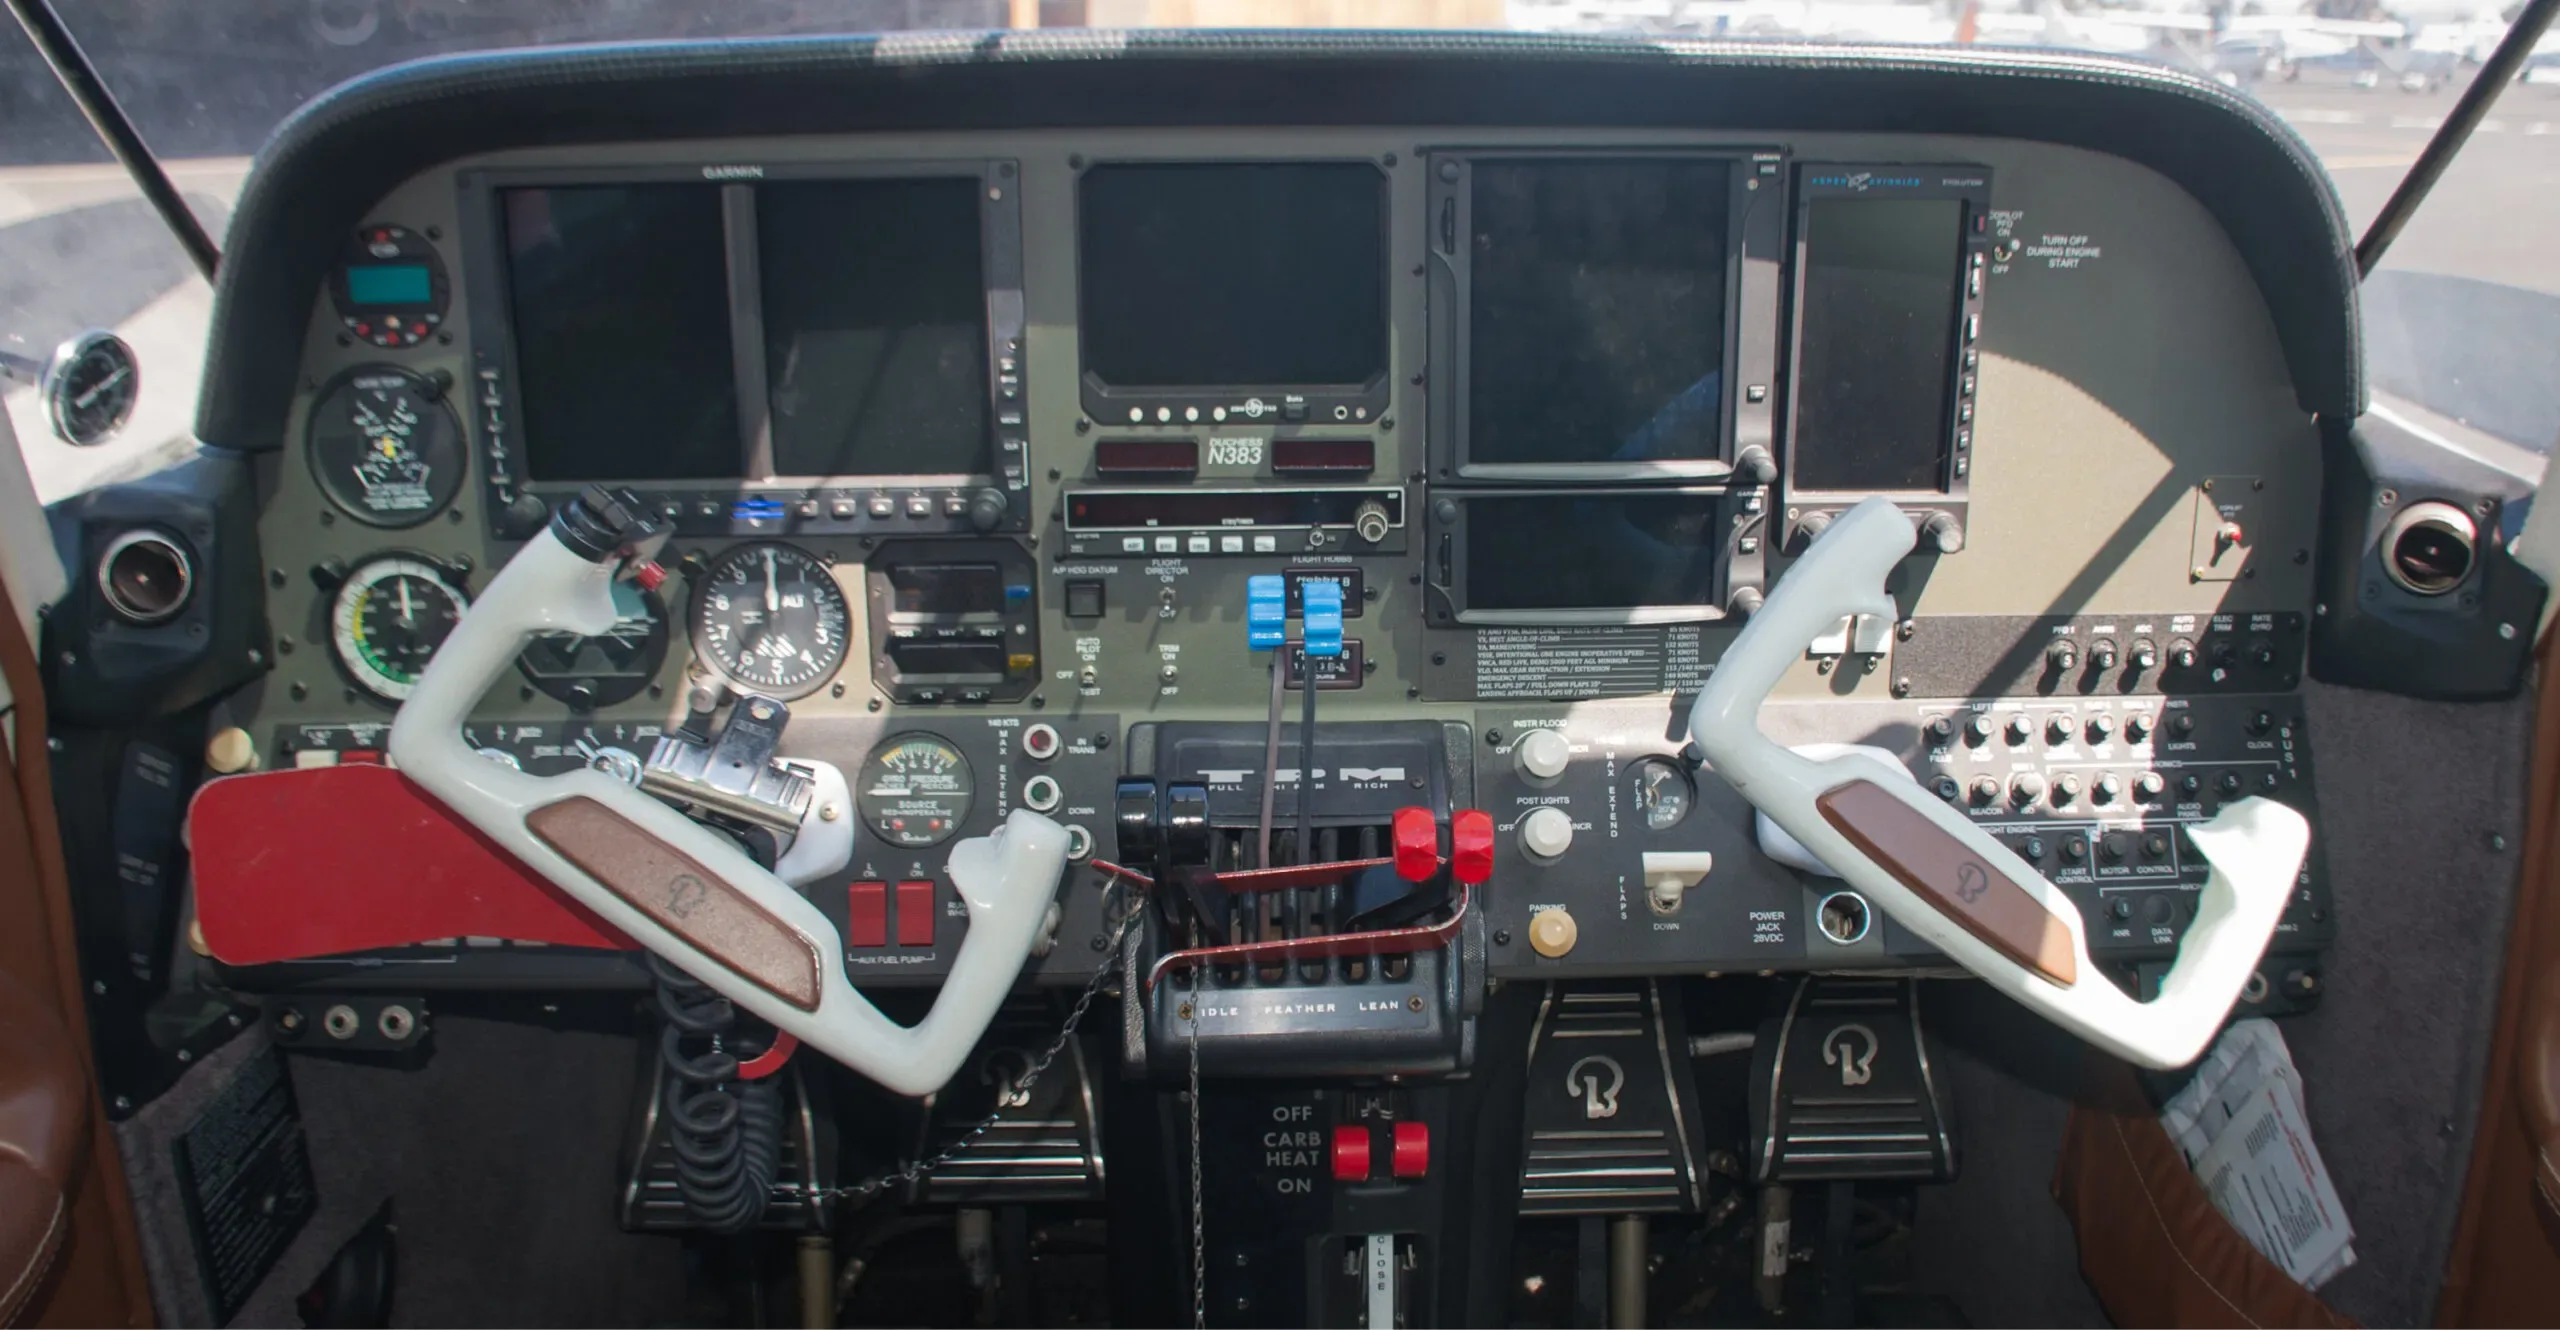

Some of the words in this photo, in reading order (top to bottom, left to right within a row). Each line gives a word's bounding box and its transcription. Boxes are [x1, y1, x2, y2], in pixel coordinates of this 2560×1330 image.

[702, 166, 764, 179] GARMIN
[2042, 235, 2068, 246] TURN
[2069, 235, 2088, 246] OFF
[2026, 246, 2064, 257] DURING
[2065, 247, 2100, 258] ENGINE
[2048, 258, 2079, 269] START
[1992, 264, 2009, 274] OFF
[1209, 437, 1263, 447] DUCHESS
[1208, 446, 1262, 465] N383
[1152, 559, 1183, 567] FLIGHT
[1292, 556, 1323, 564] FLIGHT
[1068, 566, 1087, 574] HDG
[1088, 565, 1118, 574] DATUM
[1145, 566, 1189, 575] DIRECTOR
[1160, 574, 1174, 583] ON
[813, 587, 825, 604] 2
[781, 593, 805, 608] ALT
[2172, 615, 2196, 624] AUTO
[2213, 615, 2233, 623] ELEC
[2251, 614, 2272, 622] RATE
[2214, 623, 2233, 632] TRIM
[2250, 623, 2273, 632] GYRO
[1076, 637, 1100, 646] AUTO
[1076, 645, 1101, 654] PILOT
[1159, 644, 1180, 653] TRIM
[1162, 652, 1176, 660] ON
[1056, 670, 1074, 679] OFF
[1477, 674, 1516, 682] EMERGENCY
[966, 691, 982, 699] ALT
[1080, 687, 1101, 696] TEST
[1161, 686, 1178, 695] OFF
[1477, 690, 1506, 698] LANDING
[1003, 718, 1020, 727] KTS
[1513, 719, 1538, 728] INSTR
[1539, 718, 1568, 728] FLOOD
[999, 729, 1008, 755] MAX
[1077, 737, 1087, 746] IN
[2246, 741, 2274, 749] CLOCK
[2280, 727, 2294, 763] BUS
[1067, 746, 1096, 754] TRANS
[1496, 745, 1513, 754] OFF
[1568, 744, 1589, 753] INCR
[2167, 742, 2197, 751] LIGHTS
[1606, 751, 1615, 777] MAX
[909, 774, 955, 783] PRESSURE
[1196, 769, 1256, 783] T
[1340, 767, 1406, 782] M
[999, 764, 1008, 816] EXTEND
[1208, 784, 1244, 792] FULL
[1354, 782, 1389, 790] RICH
[897, 800, 938, 809] SOURCE
[1516, 796, 1540, 805] POST
[1541, 796, 1570, 805] LIGHTS
[1068, 807, 1095, 815] DOWN
[1969, 807, 2004, 815] BEACON
[2176, 802, 2202, 811] AUDIO
[1608, 786, 1618, 838] EXTEND
[2176, 810, 2201, 819] PANEL
[881, 818, 890, 830] L
[943, 818, 954, 830] R
[1498, 823, 1515, 832] OFF
[1572, 823, 1592, 831] INCR
[2006, 825, 2037, 834] ENGINE
[863, 870, 877, 878] ON
[910, 870, 924, 878] ON
[2061, 867, 2087, 876] START
[2101, 866, 2130, 875] MOTOR
[2136, 865, 2173, 874] CONTROL
[2056, 876, 2094, 884] CONTROL
[1619, 876, 1627, 920] FLAPS
[1529, 903, 1567, 913] PARKING
[1750, 911, 1785, 922] POWER
[1653, 922, 1680, 931] DOWN
[1755, 922, 1781, 933] JACK
[2151, 927, 2173, 936] DATA
[1753, 933, 1785, 943] 28VDC
[2153, 936, 2173, 944] LINK
[859, 955, 877, 964] AUX
[878, 955, 899, 964] FUEL
[901, 955, 924, 964] PUMP
[1264, 1003, 1337, 1015] FEATHER
[1358, 1000, 1400, 1011] LEAN
[1201, 1006, 1239, 1018] IDLE
[1272, 1106, 1313, 1122] OFF
[1263, 1131, 1322, 1148] CARB
[1266, 1150, 1320, 1167] HEAT
[1277, 1178, 1312, 1194] ON
[1377, 1235, 1386, 1291] CLOSE
